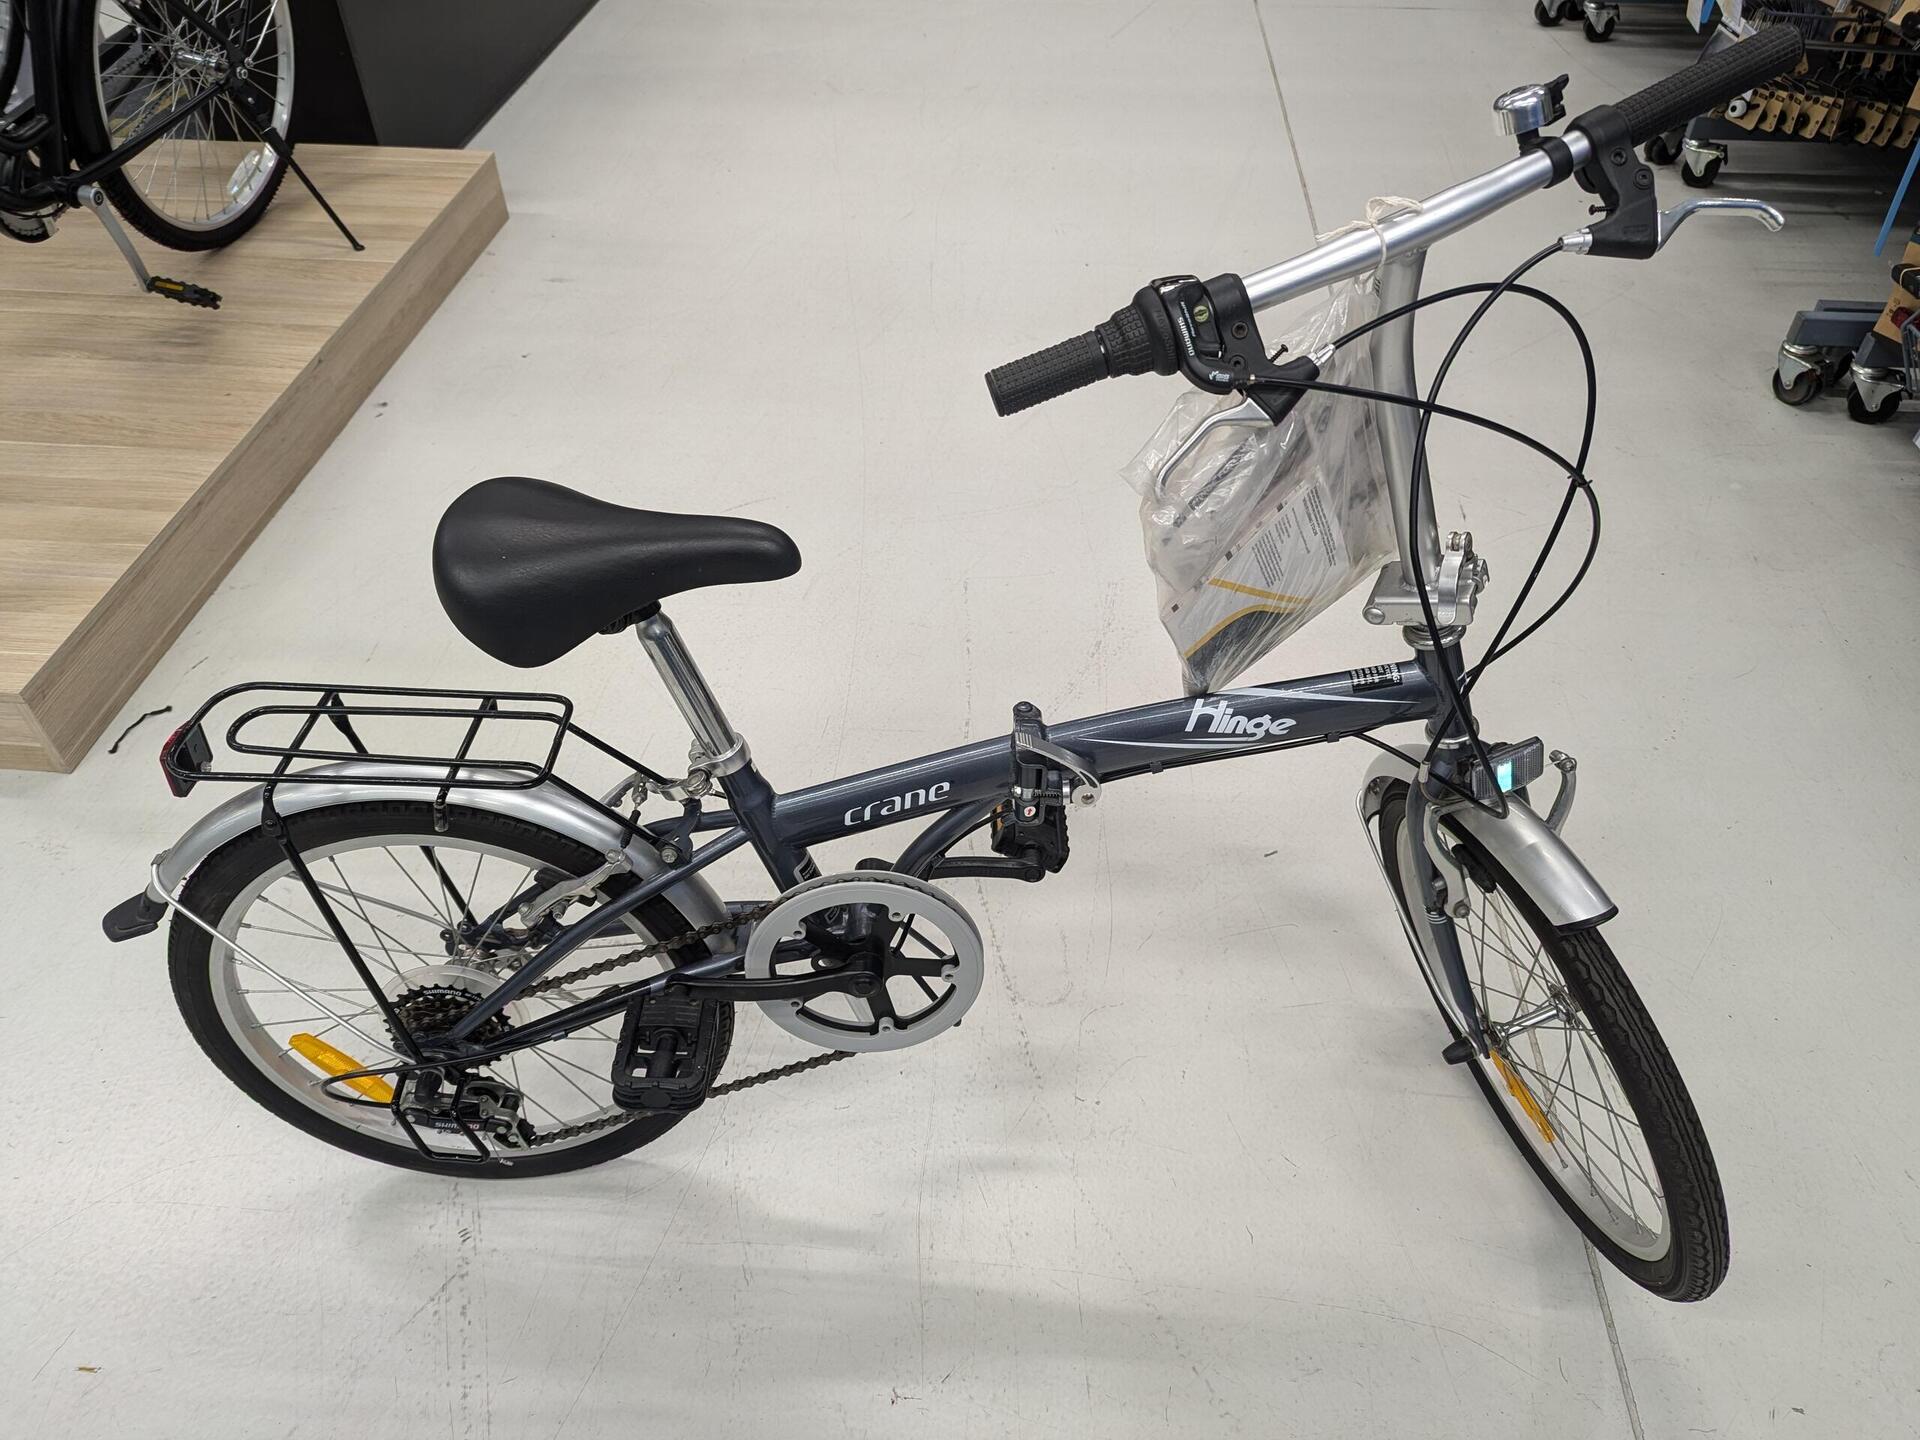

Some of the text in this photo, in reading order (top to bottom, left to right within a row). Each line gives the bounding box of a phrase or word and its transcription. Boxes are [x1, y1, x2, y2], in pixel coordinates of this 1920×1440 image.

[1177, 316, 1196, 357] SHIMANO
[1184, 698, 1297, 741] Hinge
[844, 781, 951, 826] crane
[423, 989, 462, 997] SHIMANO
[434, 1121, 481, 1131] SHIMNO
